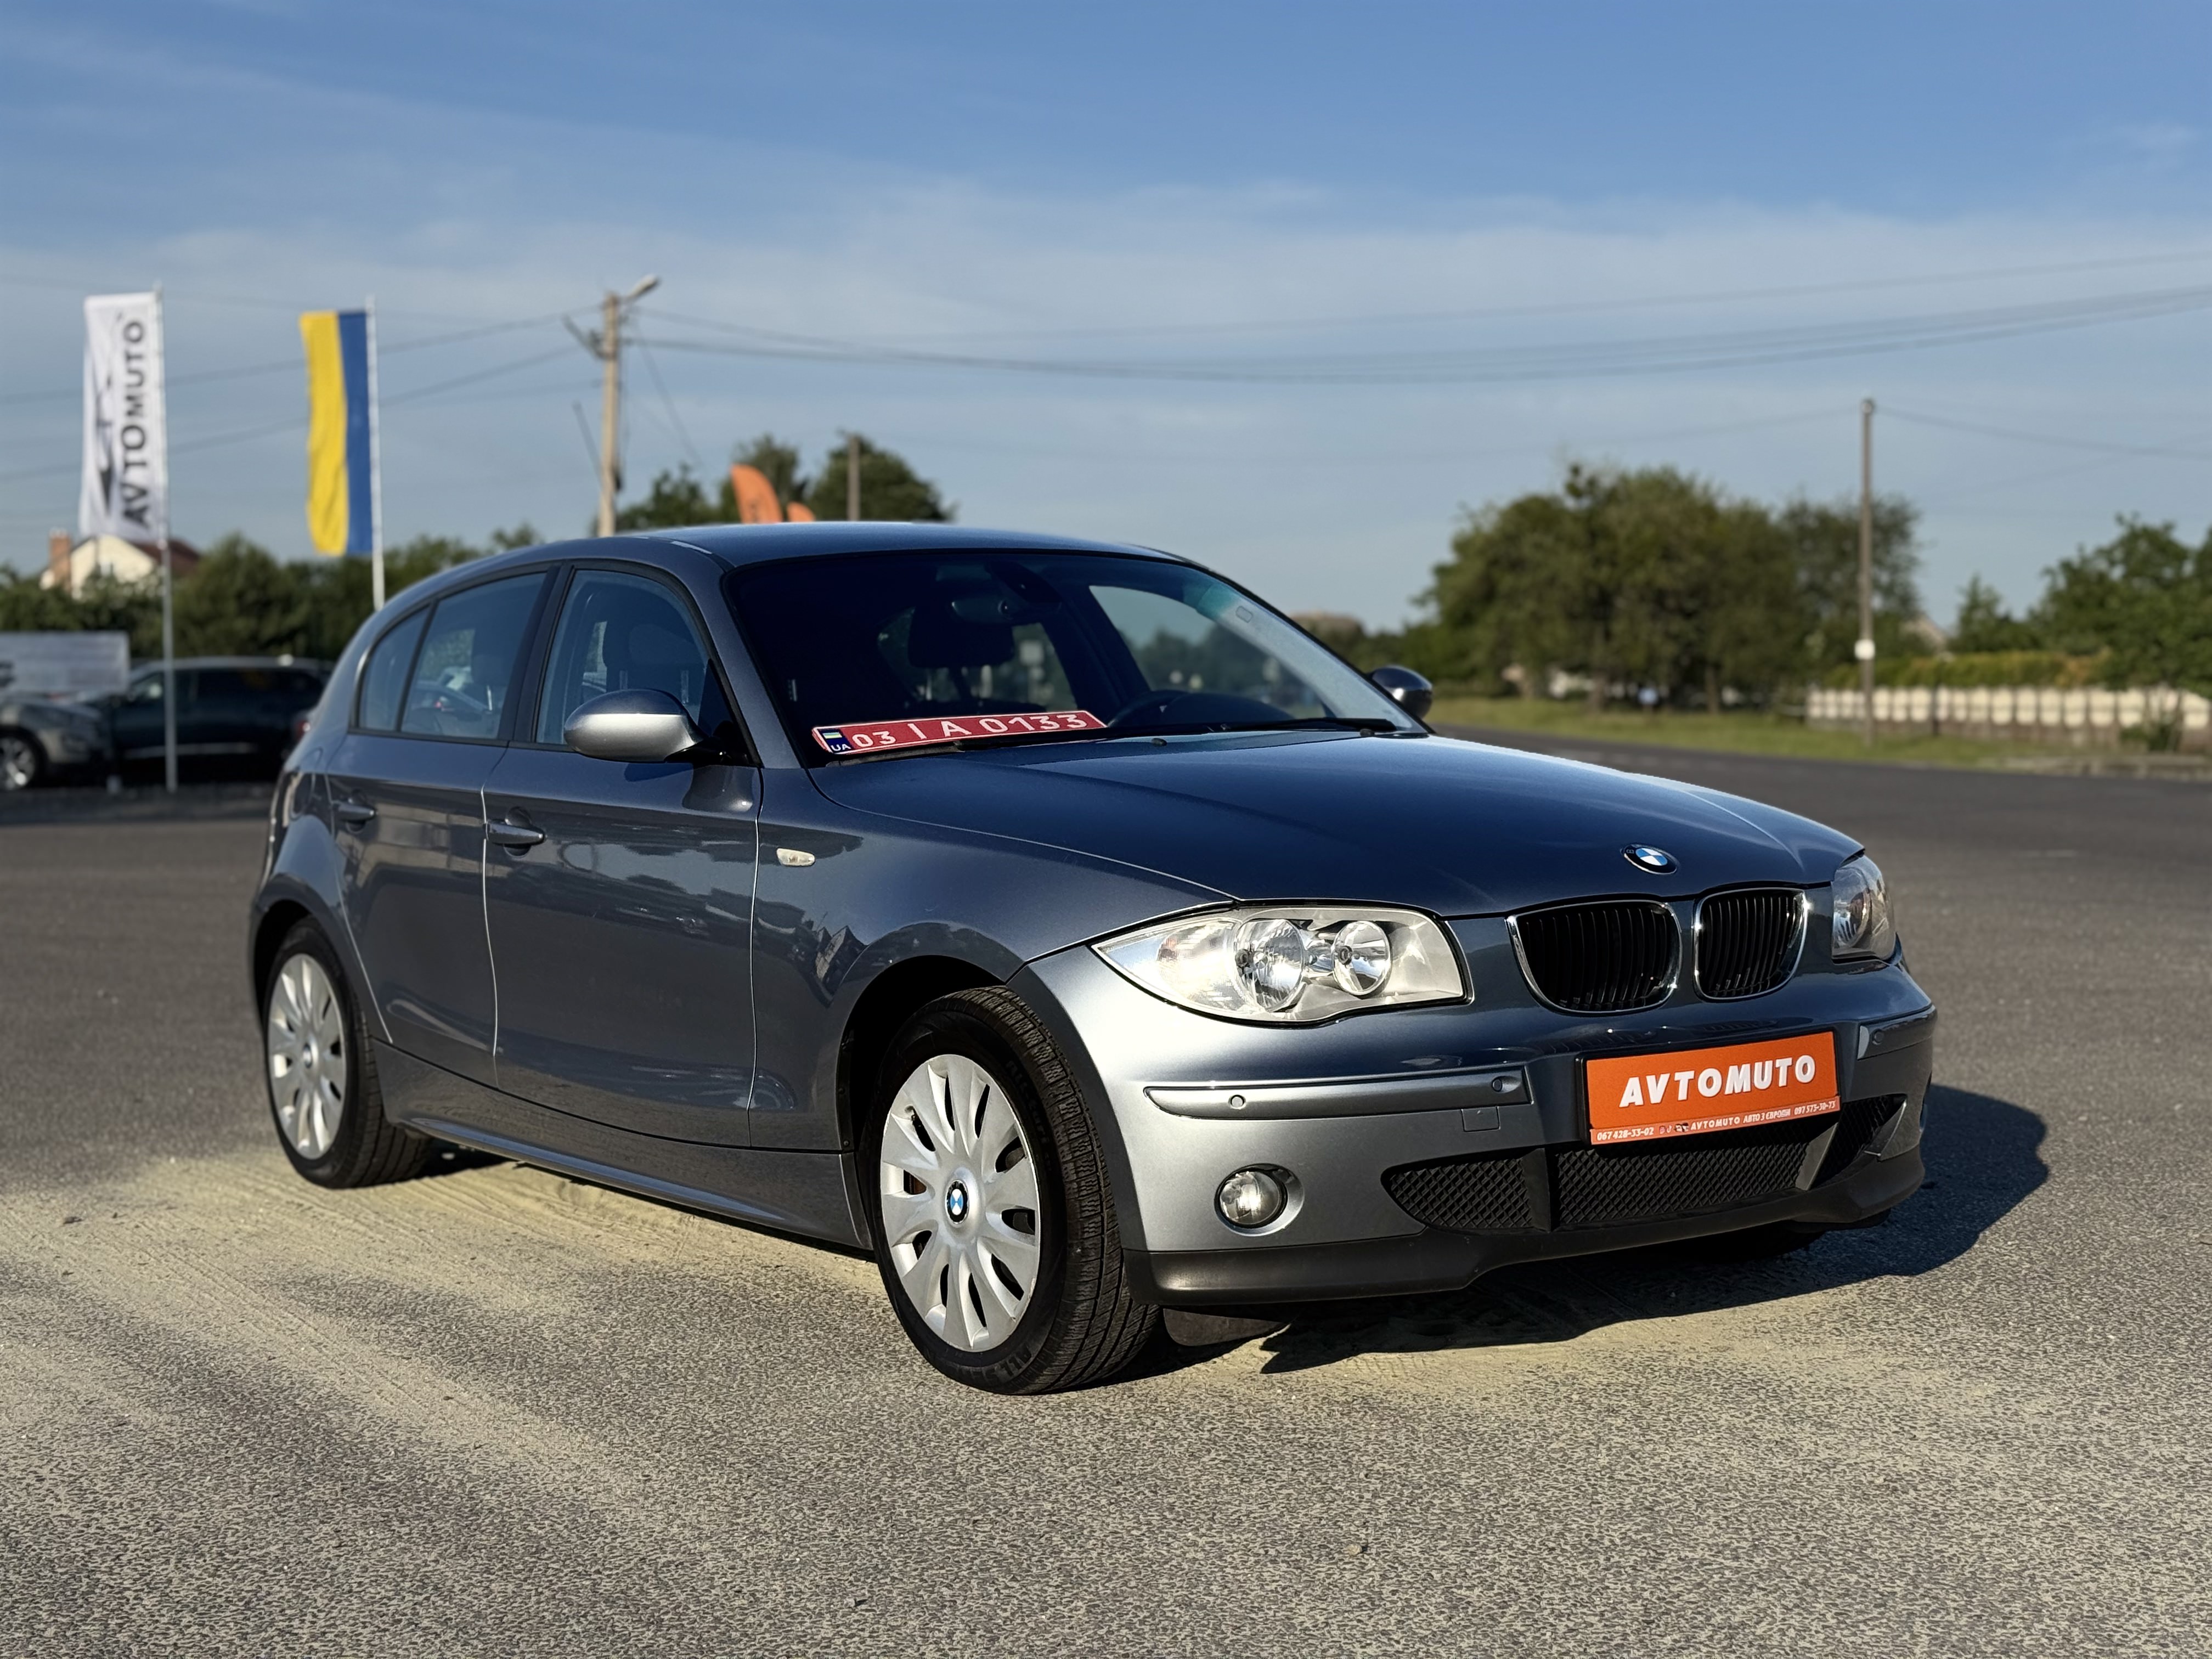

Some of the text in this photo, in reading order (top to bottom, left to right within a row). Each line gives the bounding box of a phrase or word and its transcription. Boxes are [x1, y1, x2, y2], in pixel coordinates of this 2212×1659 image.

[120, 320, 150, 531] AVTOMUTO
[851, 731, 896, 747] 03
[979, 714, 1087, 733] 0133
[831, 743, 852, 752] UA
[1618, 1054, 1816, 1108] AVTOMUTO
[1690, 1116, 1741, 1131] AVTOMUTO
